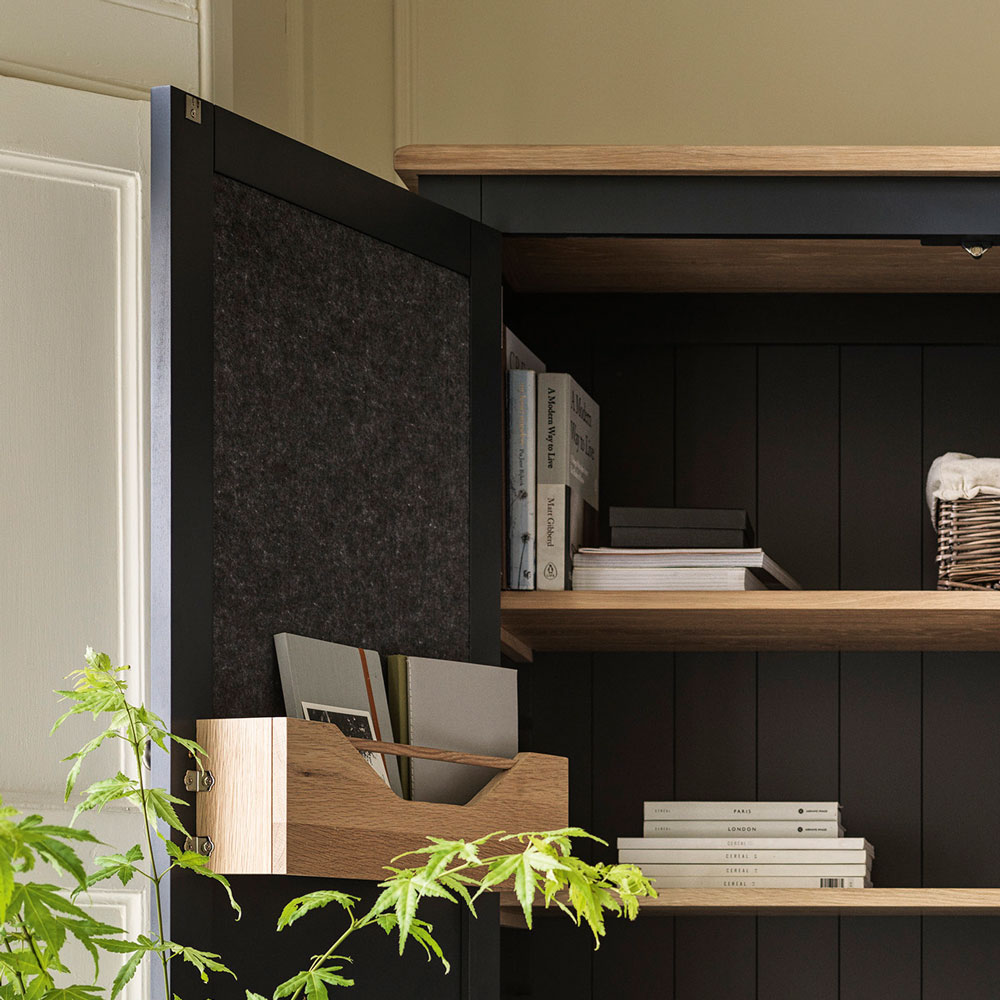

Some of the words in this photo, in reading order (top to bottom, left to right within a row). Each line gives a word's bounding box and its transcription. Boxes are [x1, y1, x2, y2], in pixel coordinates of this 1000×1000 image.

[547, 395, 555, 425] Modern
[545, 426, 555, 444] Way
[547, 444, 554, 452] to
[547, 452, 555, 469] Live
[546, 497, 555, 516] Matt
[546, 517, 555, 547] Gibberd
